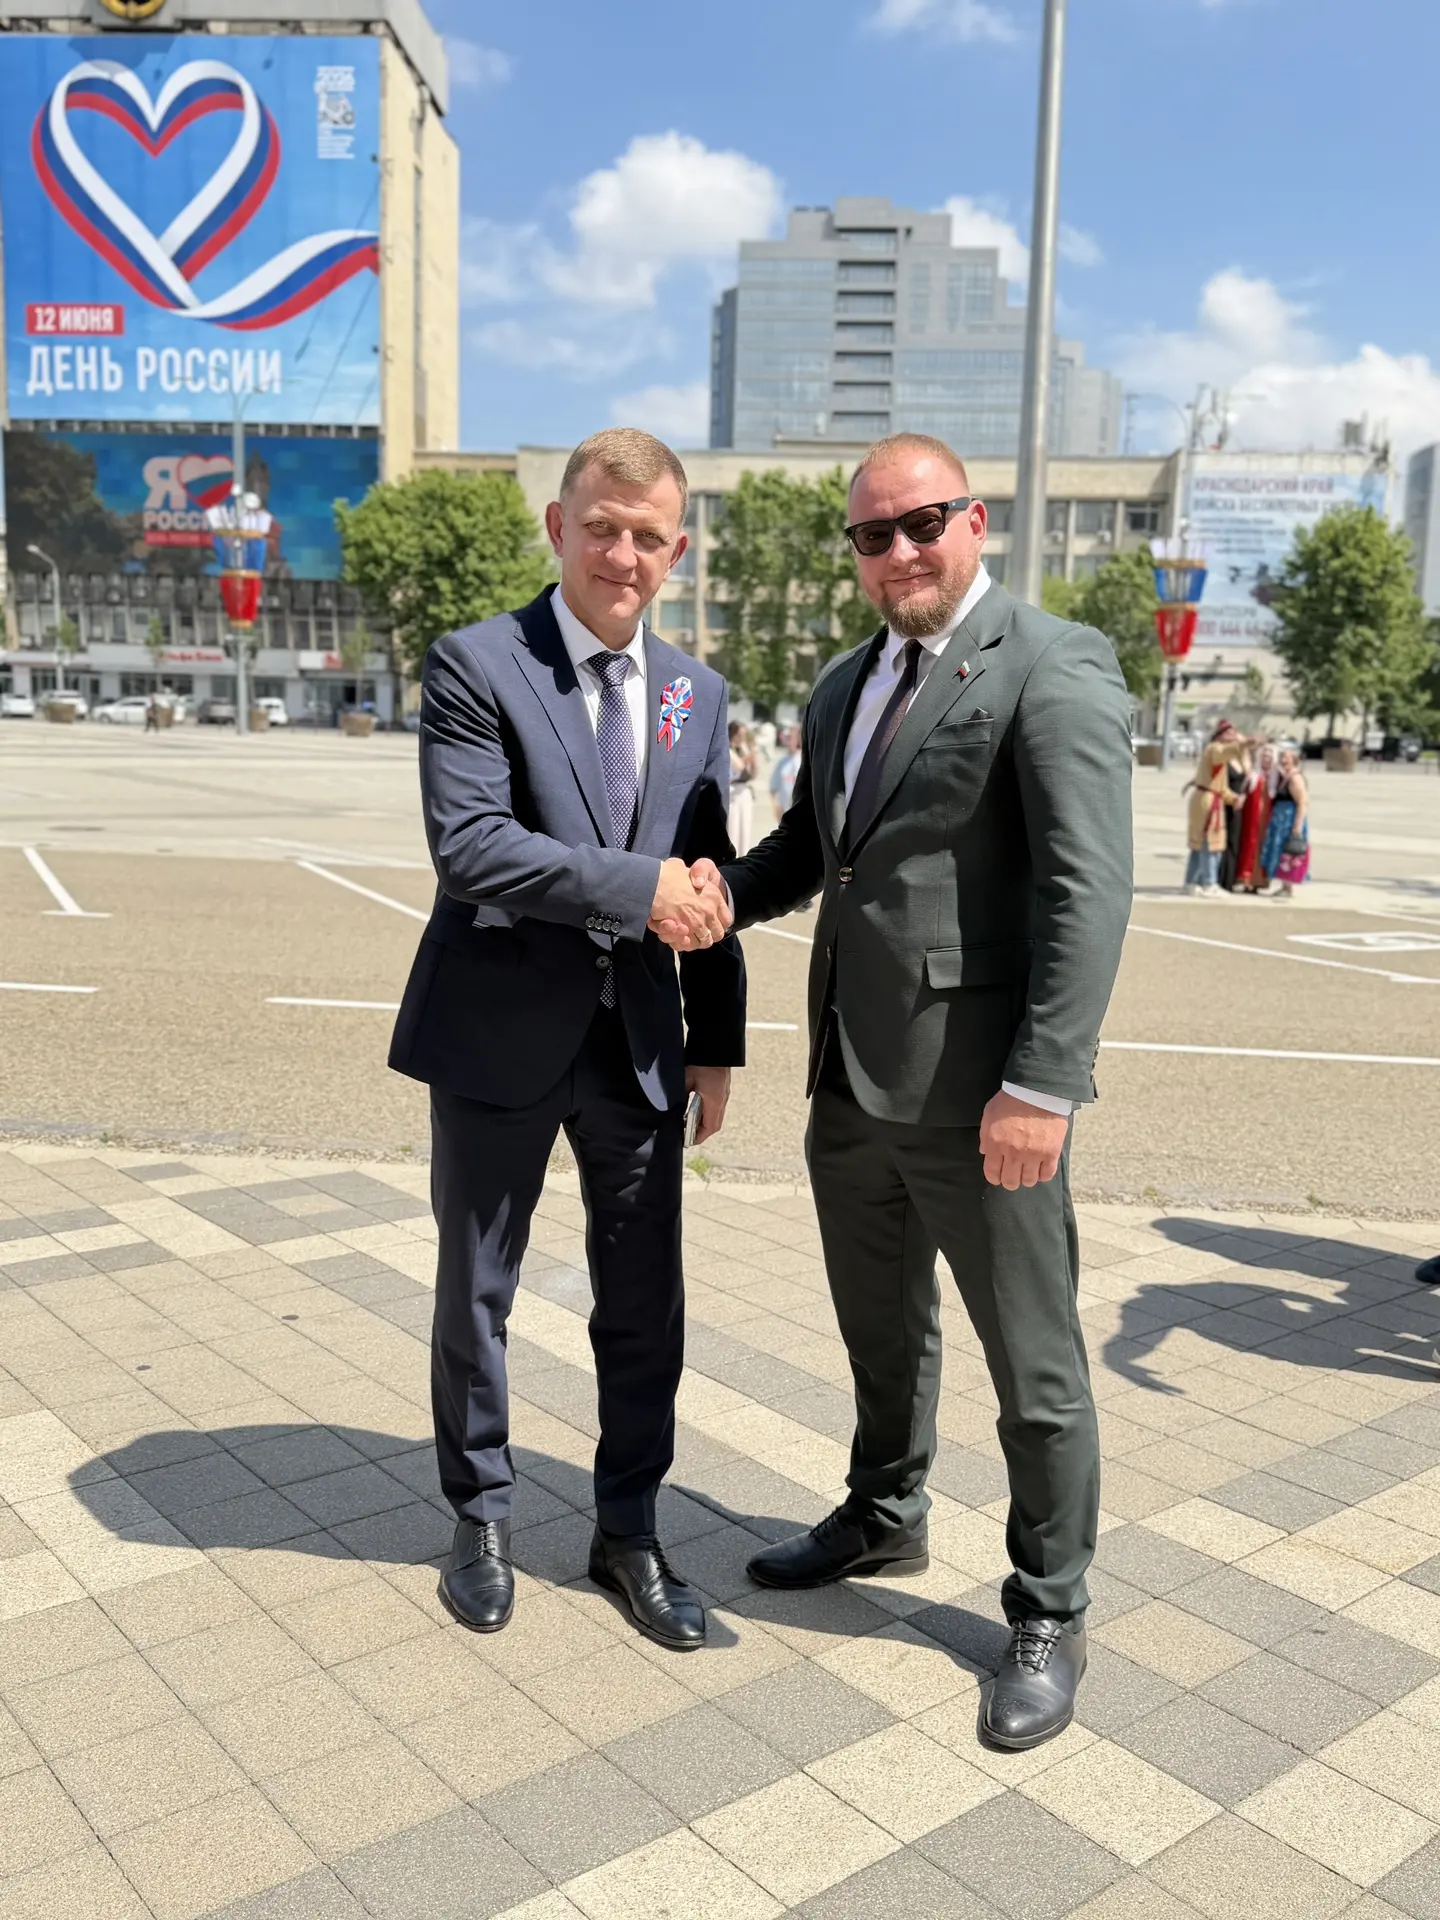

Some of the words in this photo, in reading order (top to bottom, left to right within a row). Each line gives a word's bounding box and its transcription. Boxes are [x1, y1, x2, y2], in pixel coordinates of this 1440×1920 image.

[34, 306, 55, 333] 12
[58, 306, 115, 333] ИЮНЯ
[26, 345, 124, 397] ДЕНЬ
[136, 346, 282, 395] РОССИИ
[142, 456, 188, 510] Я
[1302, 477, 1334, 493] КРАЙ
[143, 511, 208, 530] РОСС
